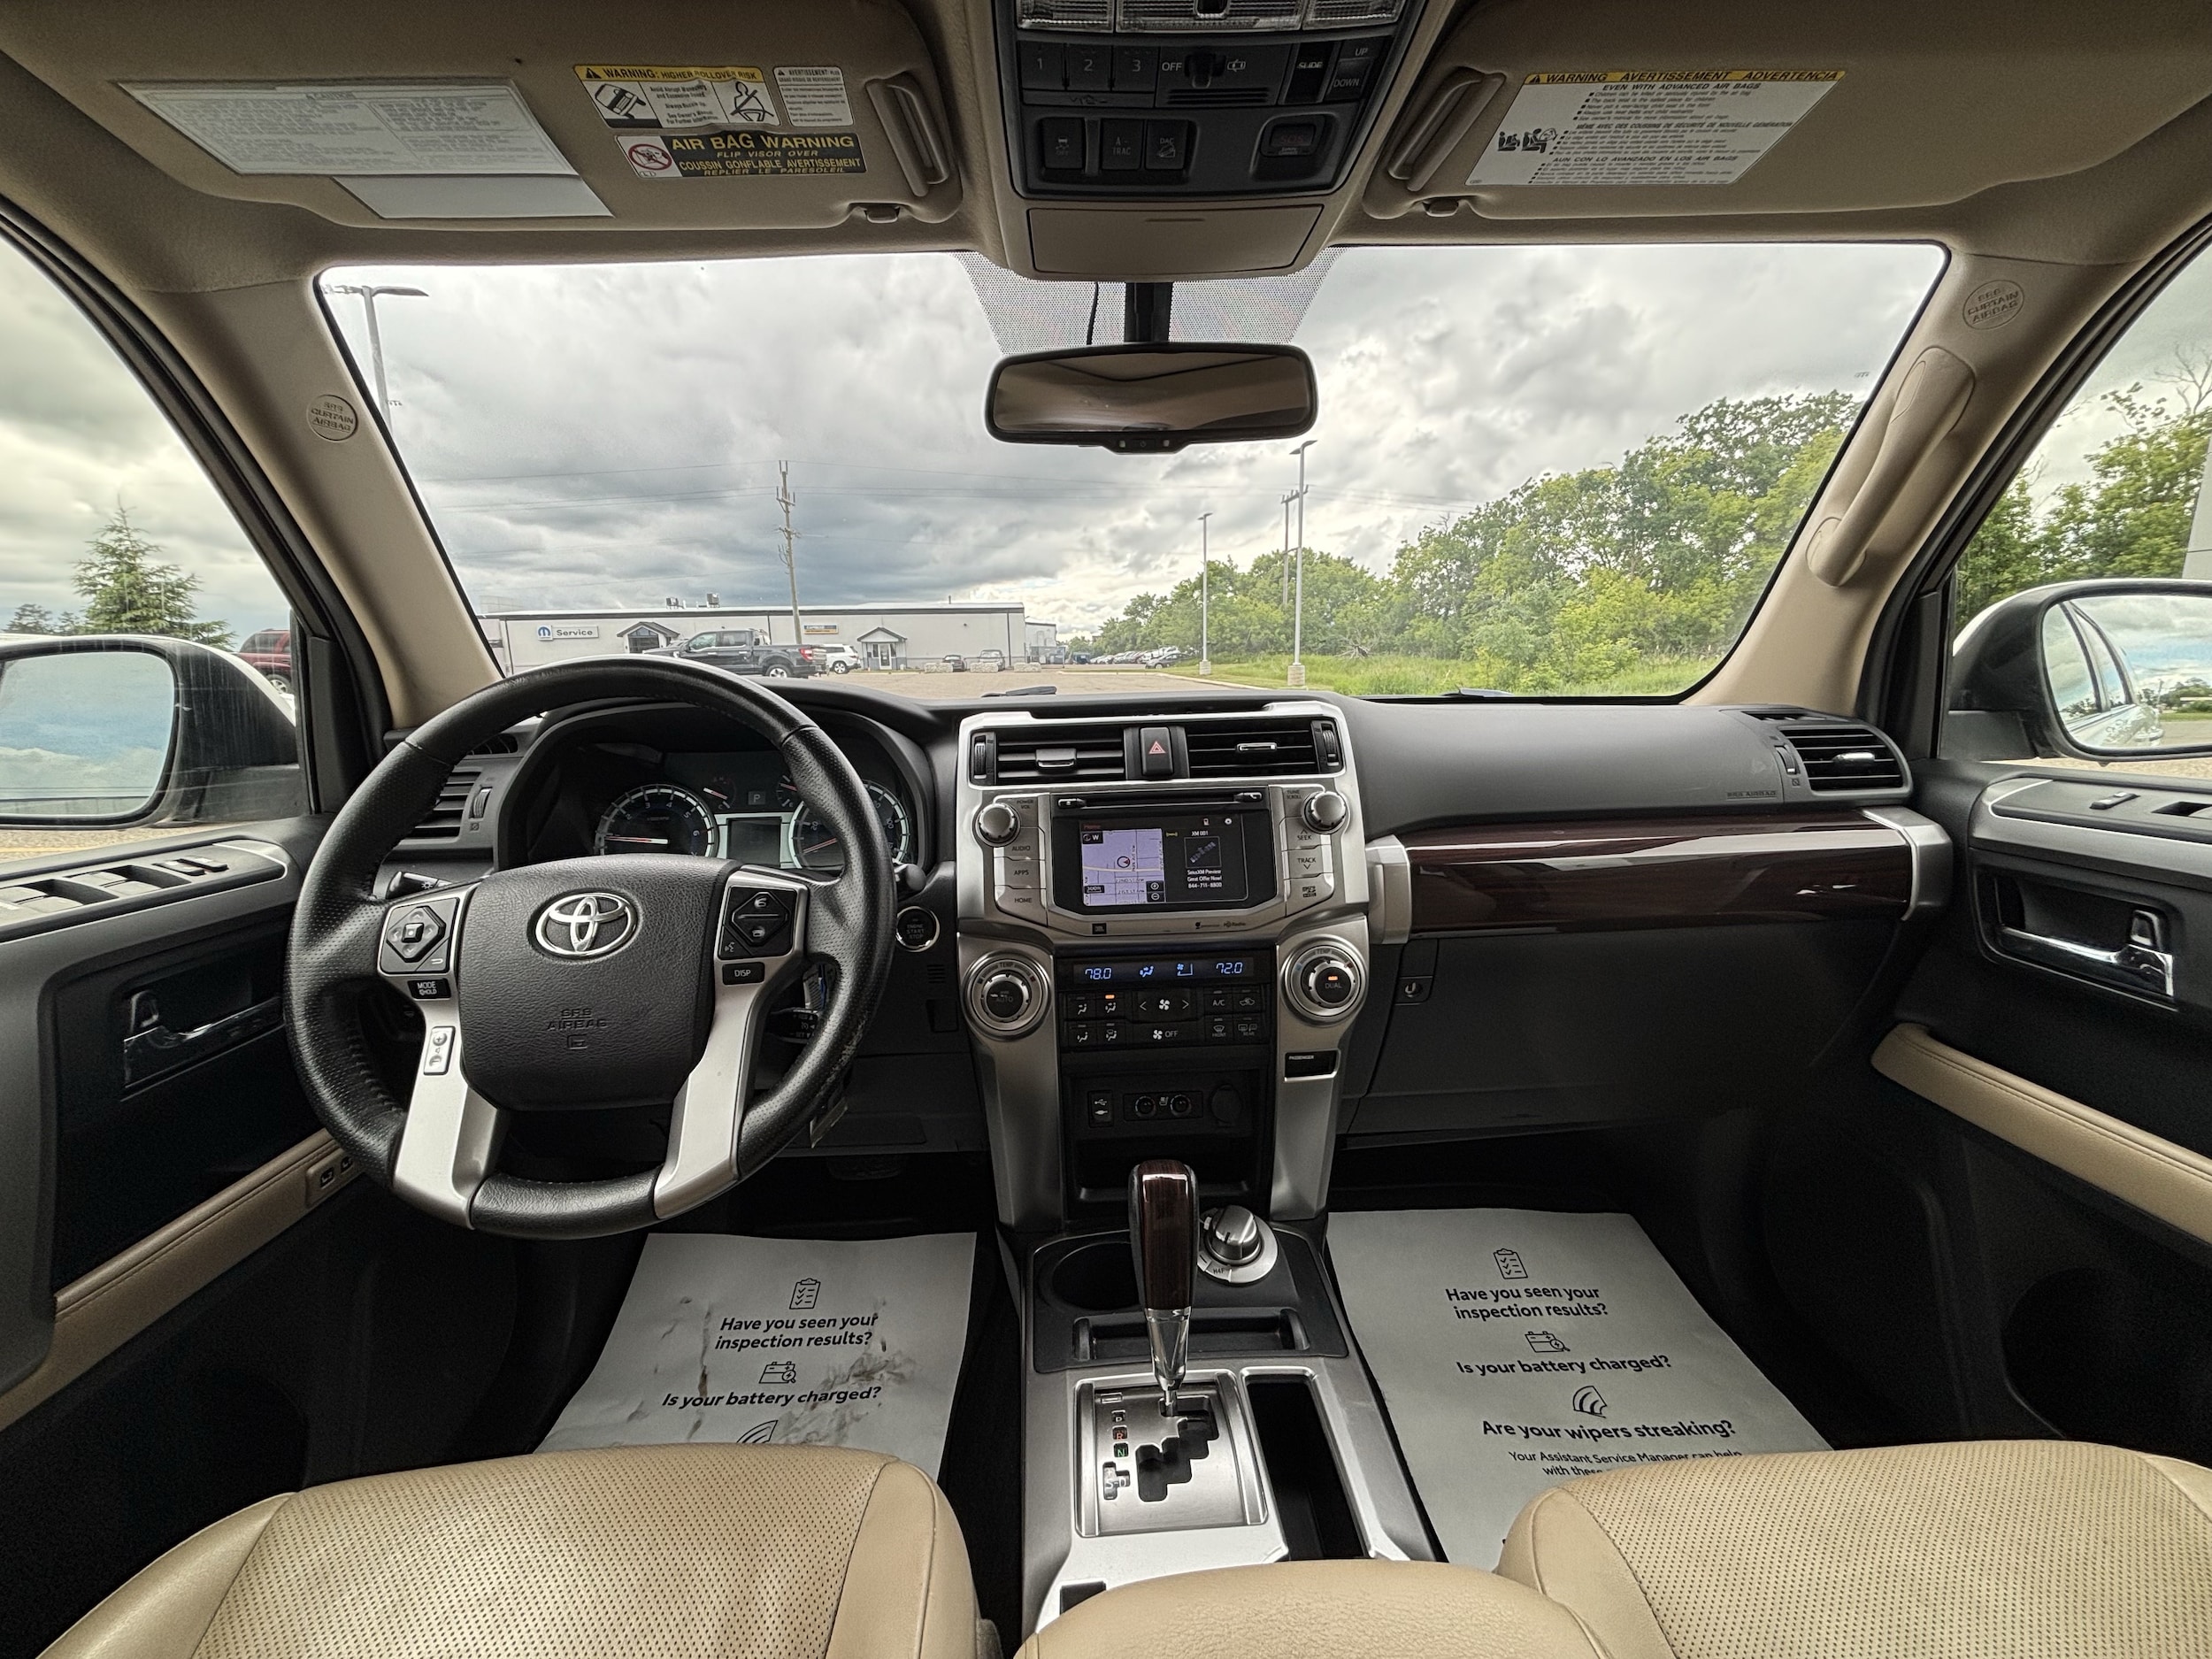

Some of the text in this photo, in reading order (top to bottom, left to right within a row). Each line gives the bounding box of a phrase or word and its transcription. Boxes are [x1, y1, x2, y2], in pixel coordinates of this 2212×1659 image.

[1355, 48, 1368, 57] UP
[1036, 58, 1044, 69] 1
[1084, 59, 1094, 72] 2
[1132, 59, 1141, 73] 3
[1162, 62, 1182, 72] OFF
[603, 68, 658, 79] WARNING:
[738, 71, 757, 80] RISK
[1546, 71, 1838, 83] WARNING AVERTISSEMENT ADVERTENCIA
[1333, 78, 1359, 88] DOWN
[672, 134, 855, 150] AIR BAG WARNING
[680, 158, 861, 171] COUSSIN GONFLABLE AVERTISSEMENT
[1968, 291, 2019, 315] CURTAIN
[311, 409, 354, 425] CURTAIN
[313, 417, 352, 432] AIRBAG
[753, 793, 761, 803] P
[645, 801, 651, 810] 3
[1085, 962, 1243, 980] 78.0 72.0
[561, 1009, 592, 1018] SRS
[548, 1019, 607, 1030] AIRBAG
[1445, 1286, 1600, 1304] Have you seen your
[1453, 1302, 1609, 1322] inspection results?
[720, 1316, 879, 1333] Have you seen your
[715, 1332, 872, 1352] inspection results?
[1456, 1355, 1672, 1377] Is your battery charged?
[662, 1386, 881, 1409] Is your battery charged?
[1482, 1420, 1736, 1442] Are your wipers streaking?
[1509, 1451, 1536, 1462] Your
[1540, 1452, 1593, 1463] Assistant
[1593, 1454, 1637, 1463] Service
[1542, 1466, 1570, 1476] with
